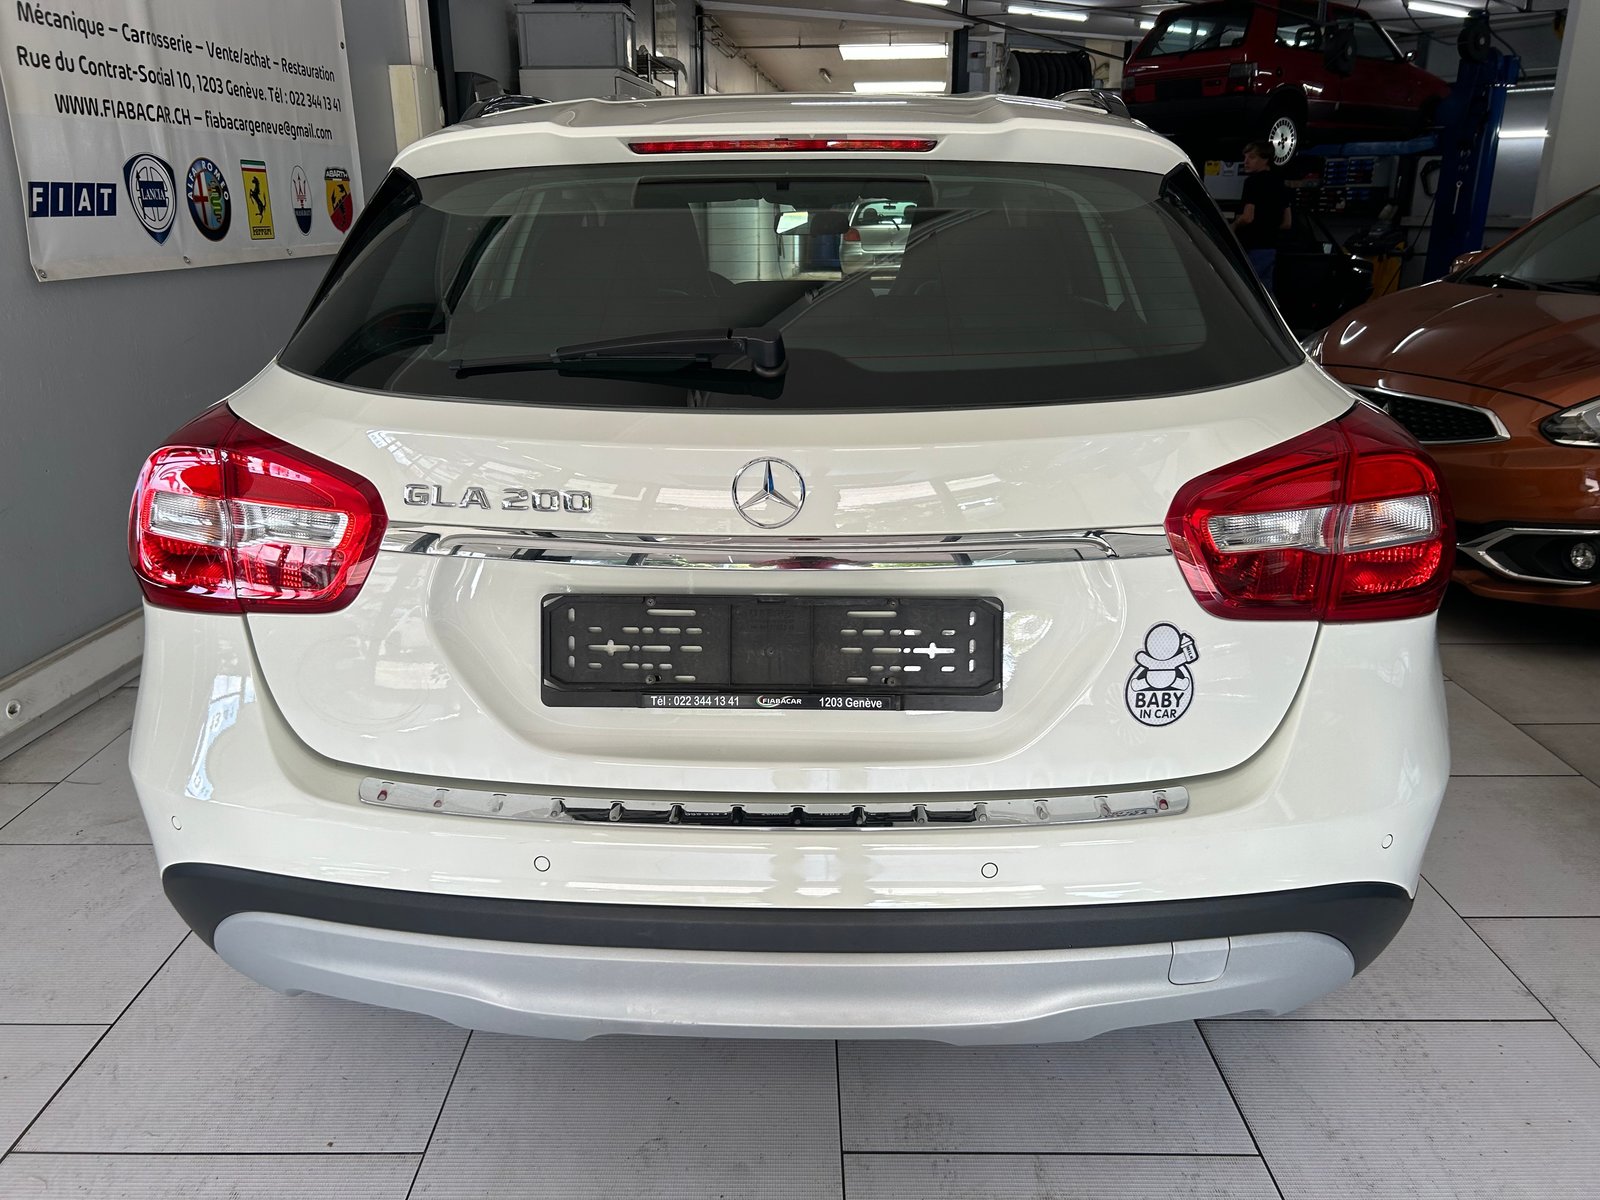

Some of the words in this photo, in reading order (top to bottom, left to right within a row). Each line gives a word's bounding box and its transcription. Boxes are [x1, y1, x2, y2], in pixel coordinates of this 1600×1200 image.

[17, 0, 104, 39] Mécanique
[122, 23, 193, 54] Carrosserie
[205, 41, 272, 69] Vente/achat
[281, 58, 335, 82] Restauration
[16, 45, 51, 69] Rue
[55, 50, 75, 72] du
[79, 55, 175, 87] Contrat-Social
[177, 71, 195, 93] 10,
[196, 74, 223, 94] 1203
[226, 80, 267, 101] Genève.
[289, 91, 306, 107] 022
[307, 93, 321, 110] 344
[323, 95, 332, 111] 13
[333, 98, 342, 112] 41
[54, 93, 191, 125] WWW.FIABACAR.CH
[205, 110, 333, 140] fiabacargeneve@gmail.com
[187, 167, 198, 200] ALFA
[201, 160, 229, 201] ROMEO
[326, 169, 348, 178] ABARTH
[32, 187, 112, 212] FIAT
[141, 187, 166, 201] LANCIA
[252, 226, 273, 236] Ferrari
[403, 483, 491, 510] GLA
[501, 488, 593, 513] 200
[673, 695, 691, 706] 022
[693, 695, 711, 706] 344
[714, 695, 726, 706] 13
[727, 695, 739, 706] 41
[762, 697, 802, 705] FIABACAR
[819, 696, 843, 708] 1203
[845, 696, 882, 708] Genève
[1135, 692, 1184, 708] BABY
[1139, 709, 1151, 719] IN
[1154, 709, 1177, 719] CAR
